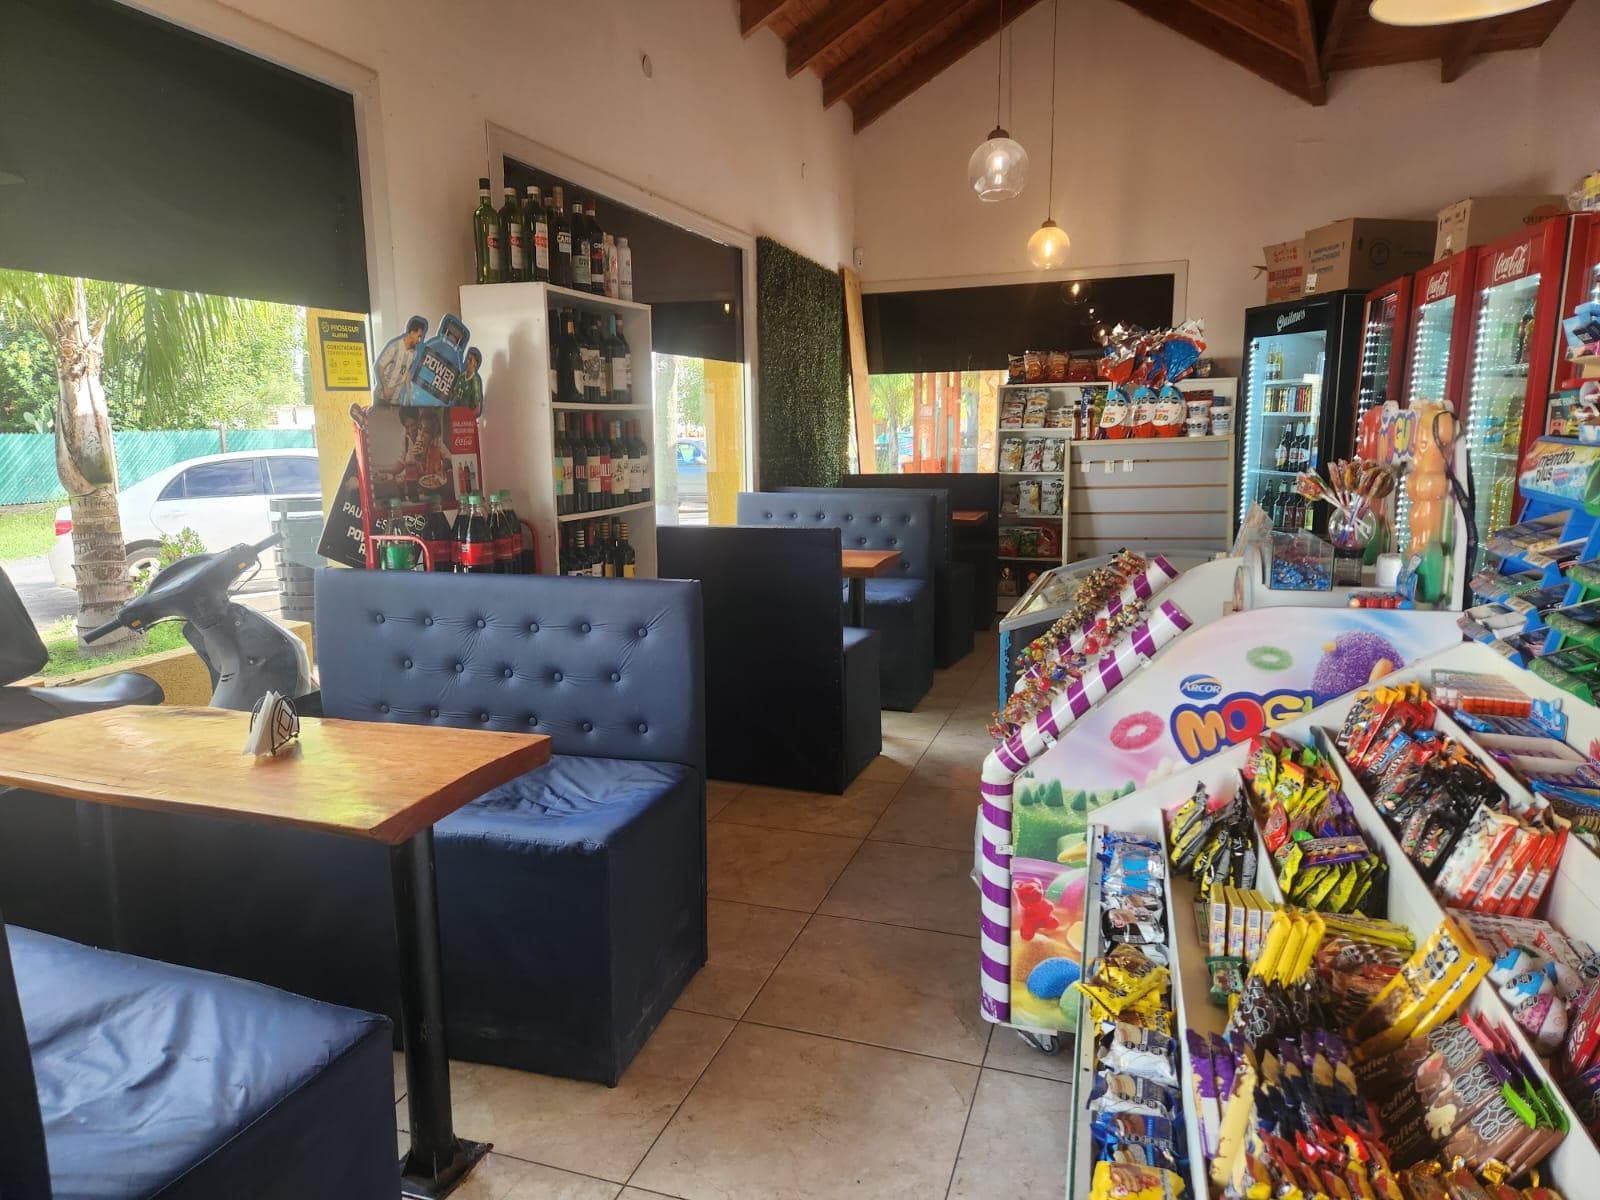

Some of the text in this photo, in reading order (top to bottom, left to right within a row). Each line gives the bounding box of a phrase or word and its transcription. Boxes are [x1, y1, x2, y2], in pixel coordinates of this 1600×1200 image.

[1276, 309, 1306, 333] Quilmes
[423, 354, 455, 385] POWER
[1181, 681, 1222, 695] ARCOR
[1176, 694, 1313, 760] MOG
